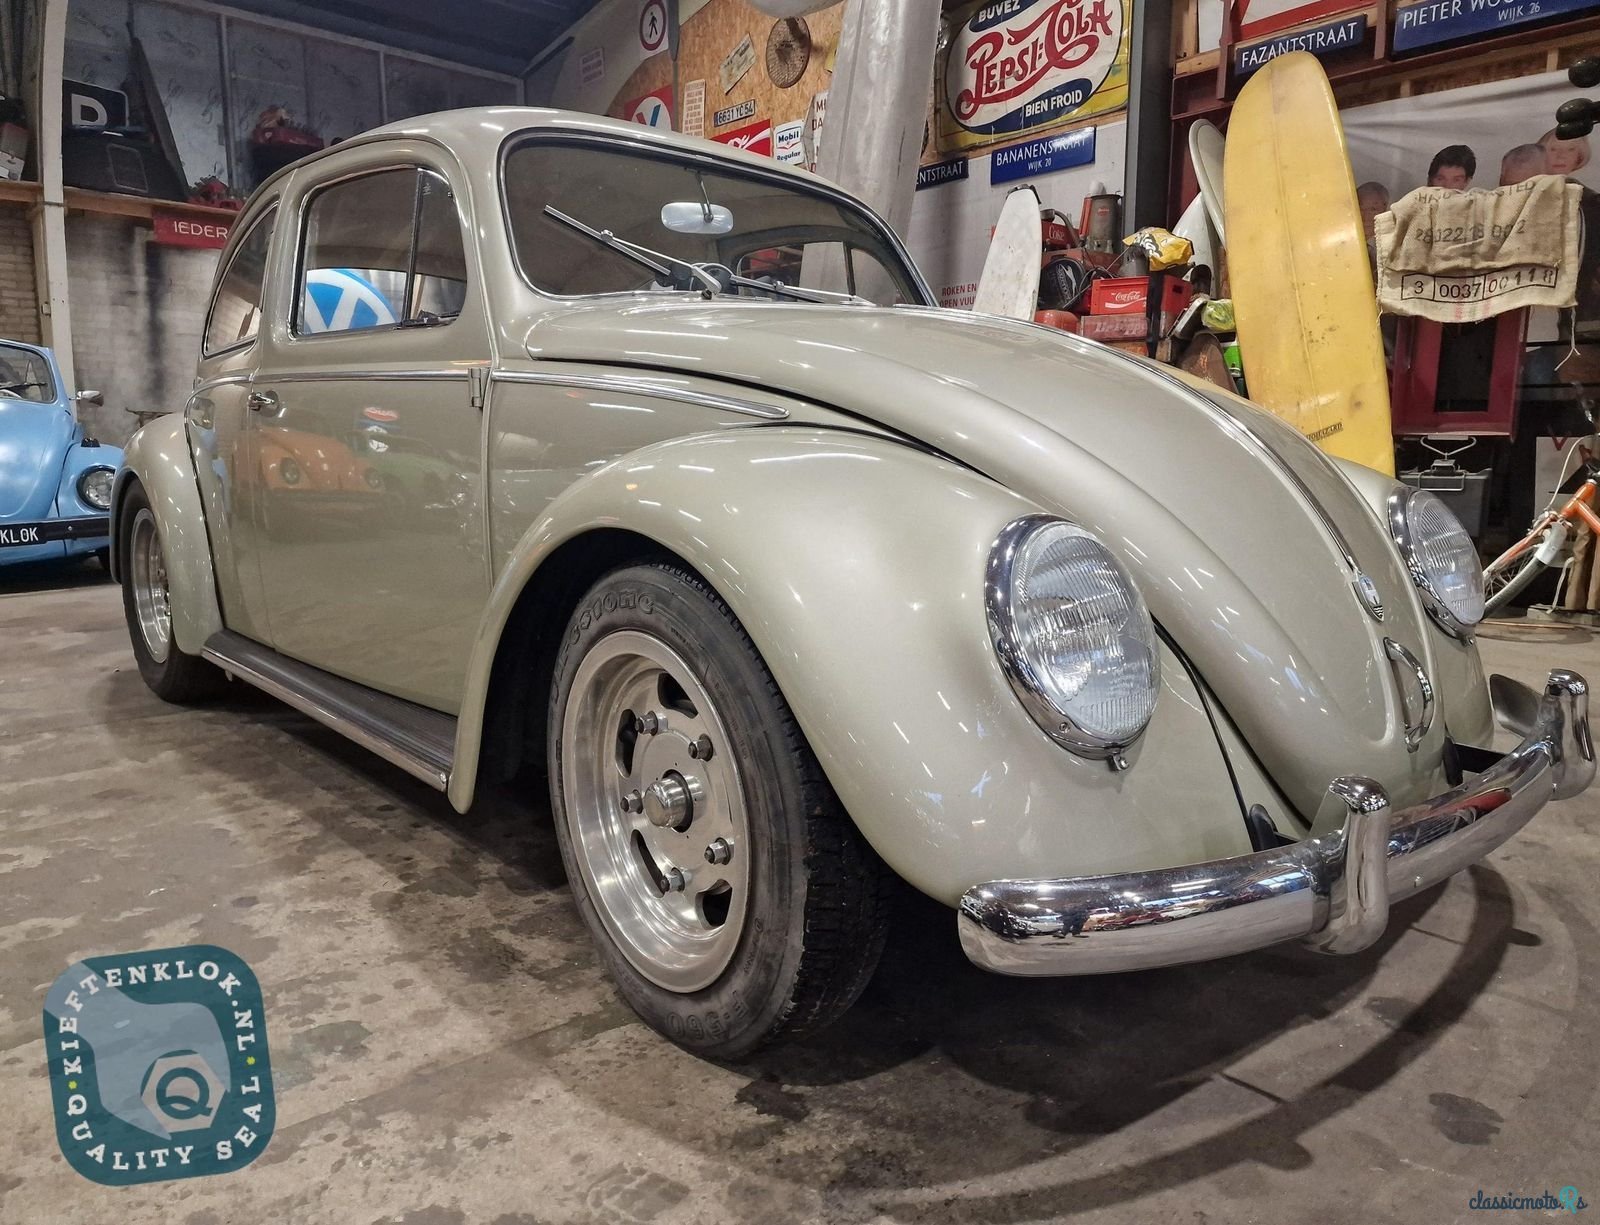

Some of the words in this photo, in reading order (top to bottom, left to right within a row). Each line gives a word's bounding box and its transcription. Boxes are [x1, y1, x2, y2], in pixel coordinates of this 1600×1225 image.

[978, 0, 1021, 22] BUVEZ
[1403, 2, 1463, 29] PIETER
[1498, 5, 1524, 21] WIJK
[1241, 22, 1358, 68] FAZANTSTRAAT
[1025, 100, 1049, 118] BIEN
[1051, 89, 1083, 110] FROID
[718, 108, 734, 124] 6631
[778, 130, 800, 143] Mobil
[776, 151, 801, 161] Regular
[915, 160, 964, 185] NTSTRAAT
[1027, 160, 1043, 173] WIJK
[1044, 157, 1052, 168] 20
[942, 284, 966, 297] ROKEN
[967, 283, 977, 293] EN
[1414, 280, 1425, 295] 3
[1439, 282, 1482, 299] 0037
